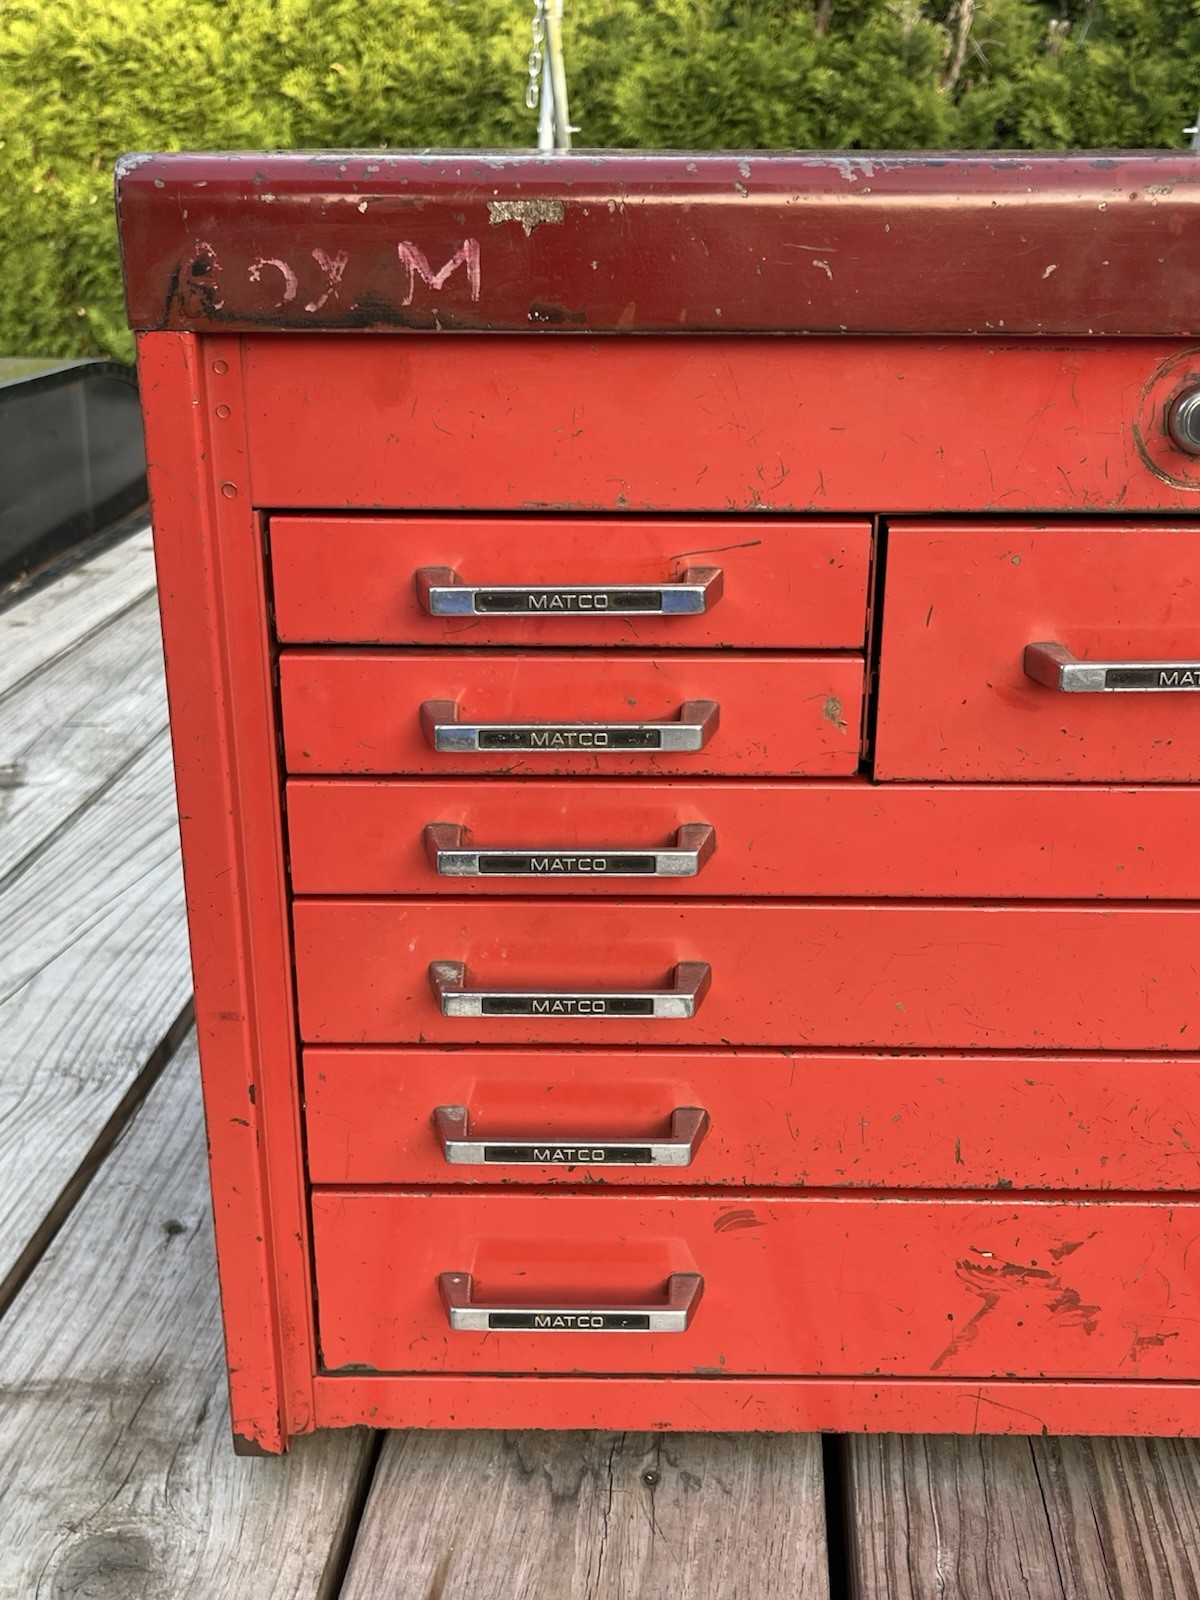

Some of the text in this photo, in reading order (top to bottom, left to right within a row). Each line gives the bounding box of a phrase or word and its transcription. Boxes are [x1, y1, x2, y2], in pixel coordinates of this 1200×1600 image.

[397, 237, 481, 306] M
[528, 594, 609, 609] MATCO
[530, 732, 609, 746] MATCO
[530, 858, 607, 871] MATCO
[532, 1000, 606, 1013] MATCO
[533, 1149, 605, 1161] MATCO
[534, 1316, 604, 1328] MATCO
